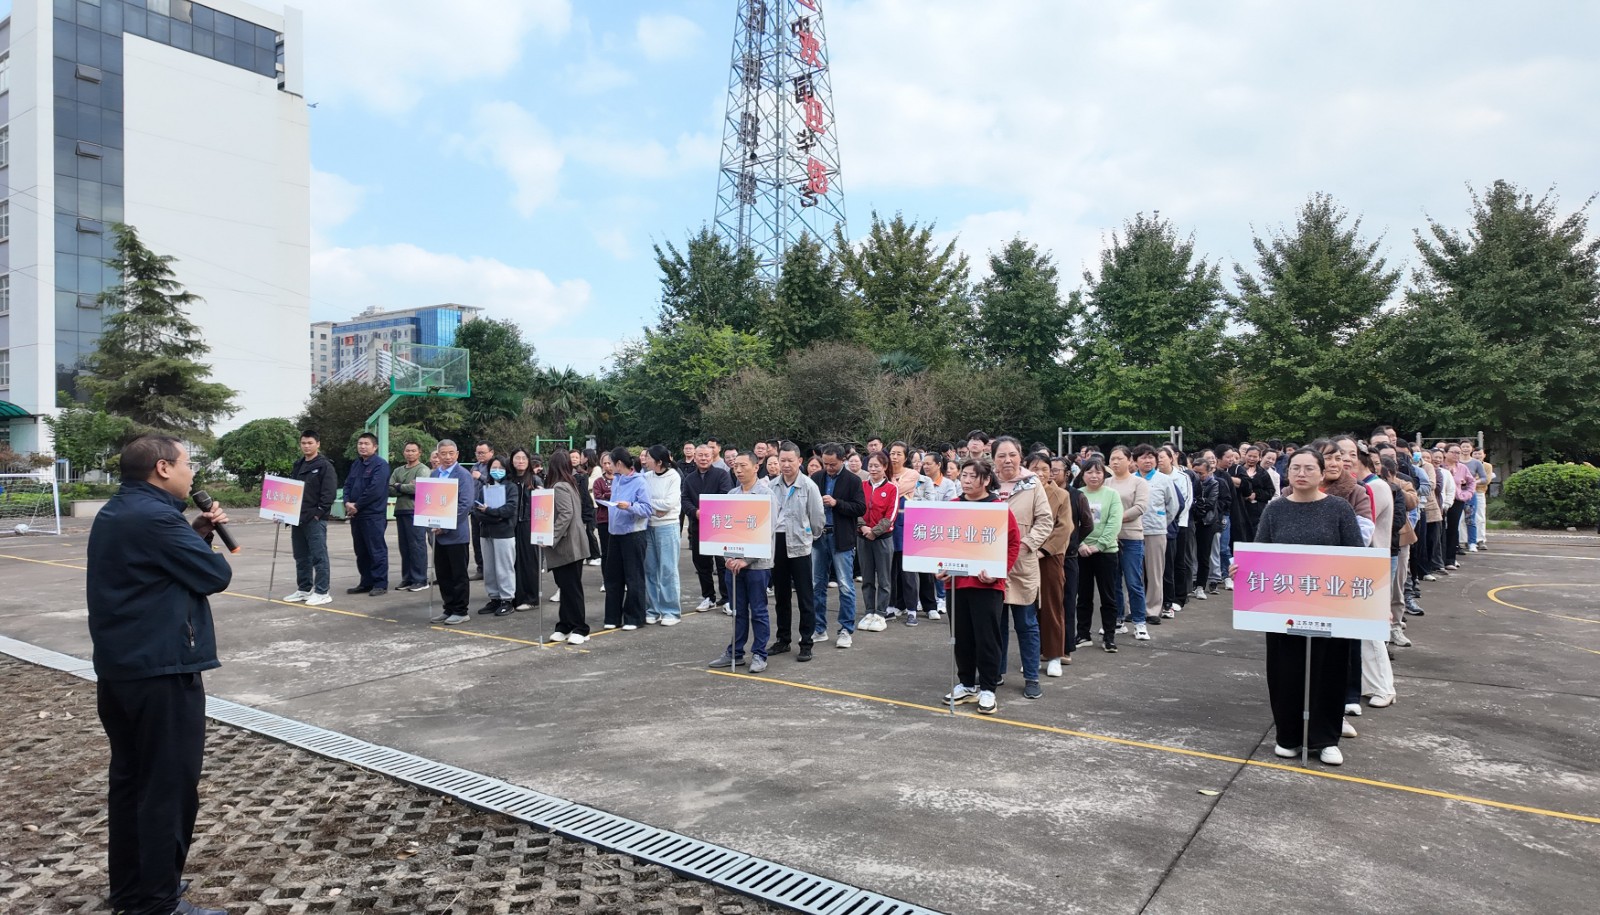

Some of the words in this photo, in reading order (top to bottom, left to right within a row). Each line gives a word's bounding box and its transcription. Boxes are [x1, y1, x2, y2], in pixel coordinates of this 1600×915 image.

[796, 0, 828, 195] 欢迎您
[711, 513, 757, 530] 特艺一部
[912, 523, 997, 545] 编织事业部
[1246, 571, 1374, 600] 针织事业部
